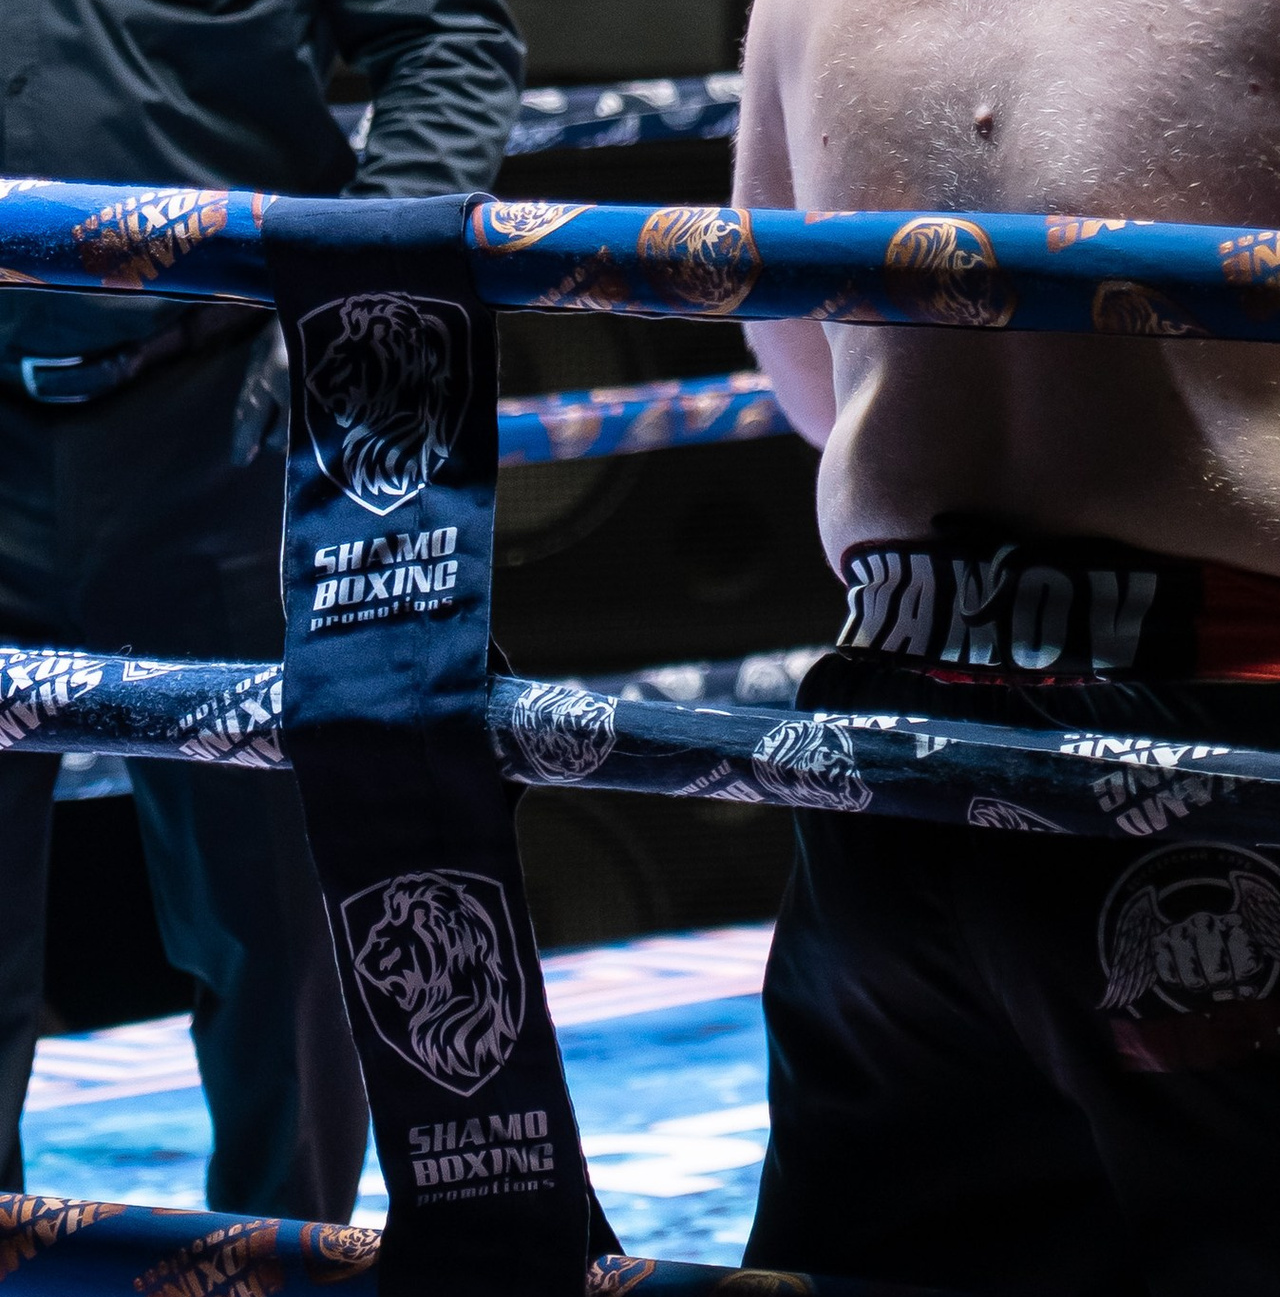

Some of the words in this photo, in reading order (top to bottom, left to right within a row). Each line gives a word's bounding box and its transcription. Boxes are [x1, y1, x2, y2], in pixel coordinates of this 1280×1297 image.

[315, 526, 458, 578] SHAMO
[313, 560, 458, 611] BOXING
[310, 595, 454, 632] promotions
[408, 1110, 548, 1154] SHAMO
[412, 1143, 554, 1186] BOXING
[417, 1179, 555, 1207] promotions
